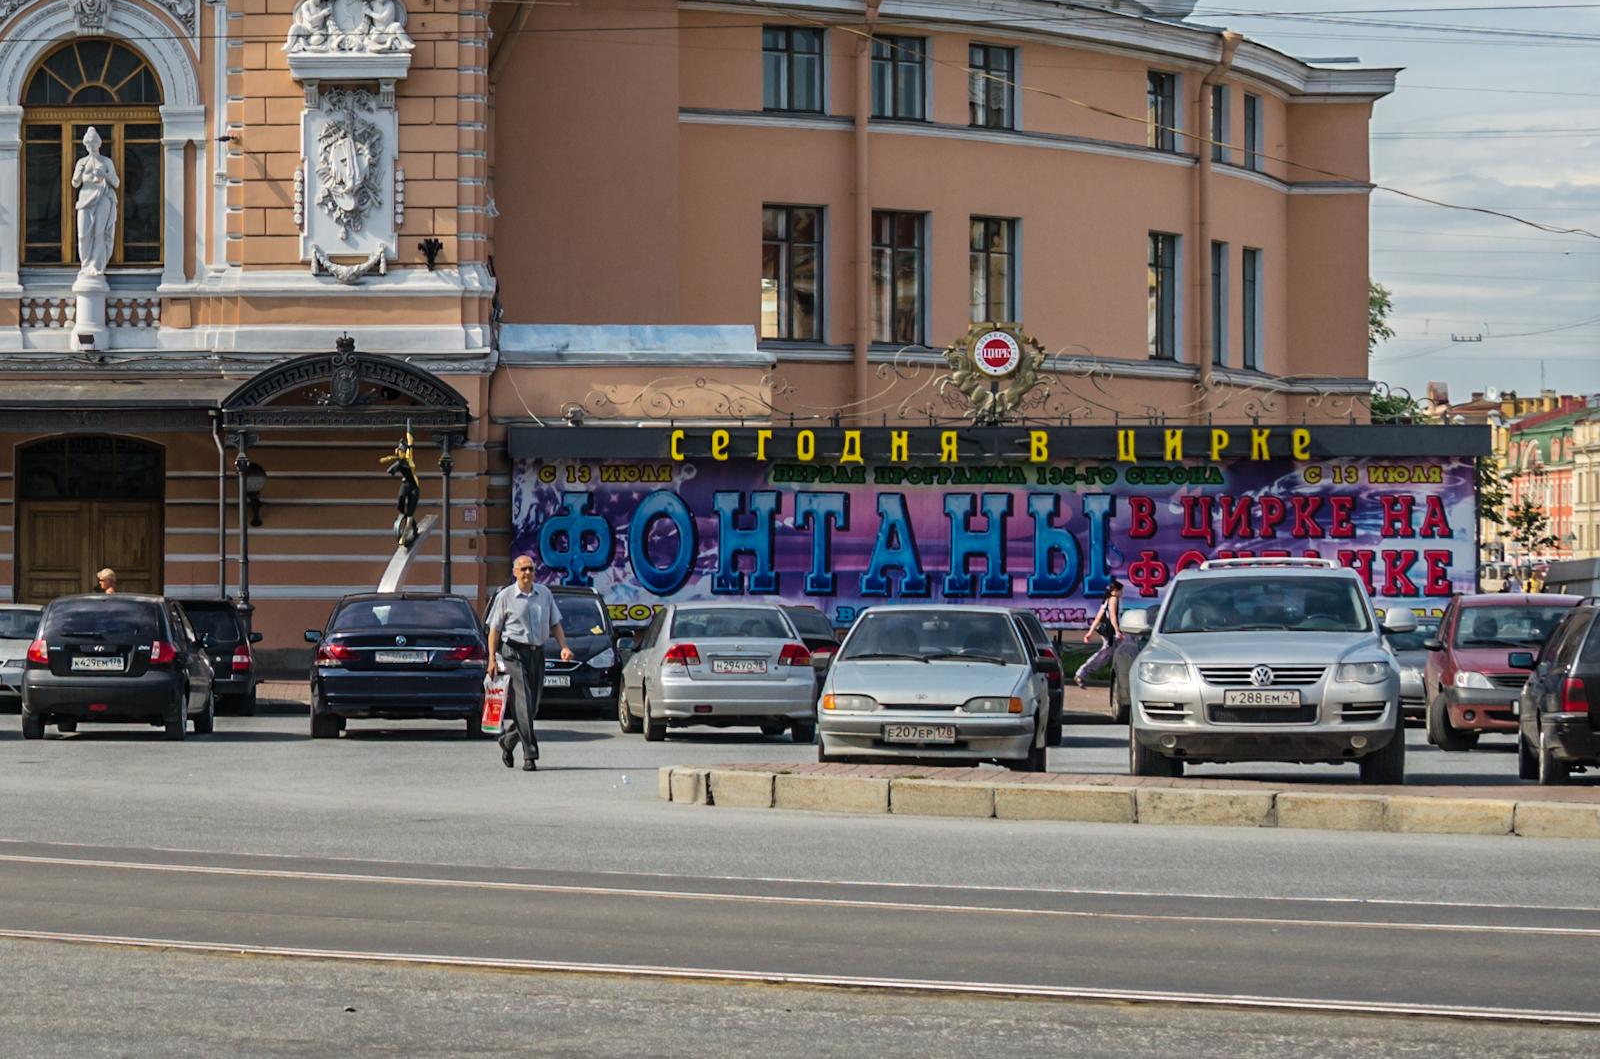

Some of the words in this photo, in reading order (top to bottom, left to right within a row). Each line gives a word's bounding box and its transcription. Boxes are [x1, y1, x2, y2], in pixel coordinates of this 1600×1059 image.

[982, 347, 1011, 360] ЦИРК
[538, 465, 557, 483] С
[566, 465, 592, 483] 13
[599, 464, 673, 483] ИЮЛЯ
[773, 464, 867, 484] ПЕРВАЯ
[874, 465, 1027, 485] ПРОГРАММА
[1036, 465, 1118, 485] 135-ГО
[1124, 465, 1225, 485] СЕЗОНА
[1303, 466, 1322, 484] С
[1332, 465, 1359, 484] 13
[1367, 465, 1444, 484] ИЮЛЯ
[1128, 496, 1158, 539] В
[1180, 496, 1355, 546] ЦИРКЕ
[1379, 496, 1454, 539] НА
[538, 489, 1117, 598] ФОНТАНЫ
[74, 658, 108, 667] К429ЕМ
[716, 660, 752, 670] Н294УО
[1230, 692, 1280, 704] У288ЕМ
[1283, 691, 1295, 703] 47
[887, 726, 933, 738] Е207ЕР
[935, 725, 953, 738] 178
